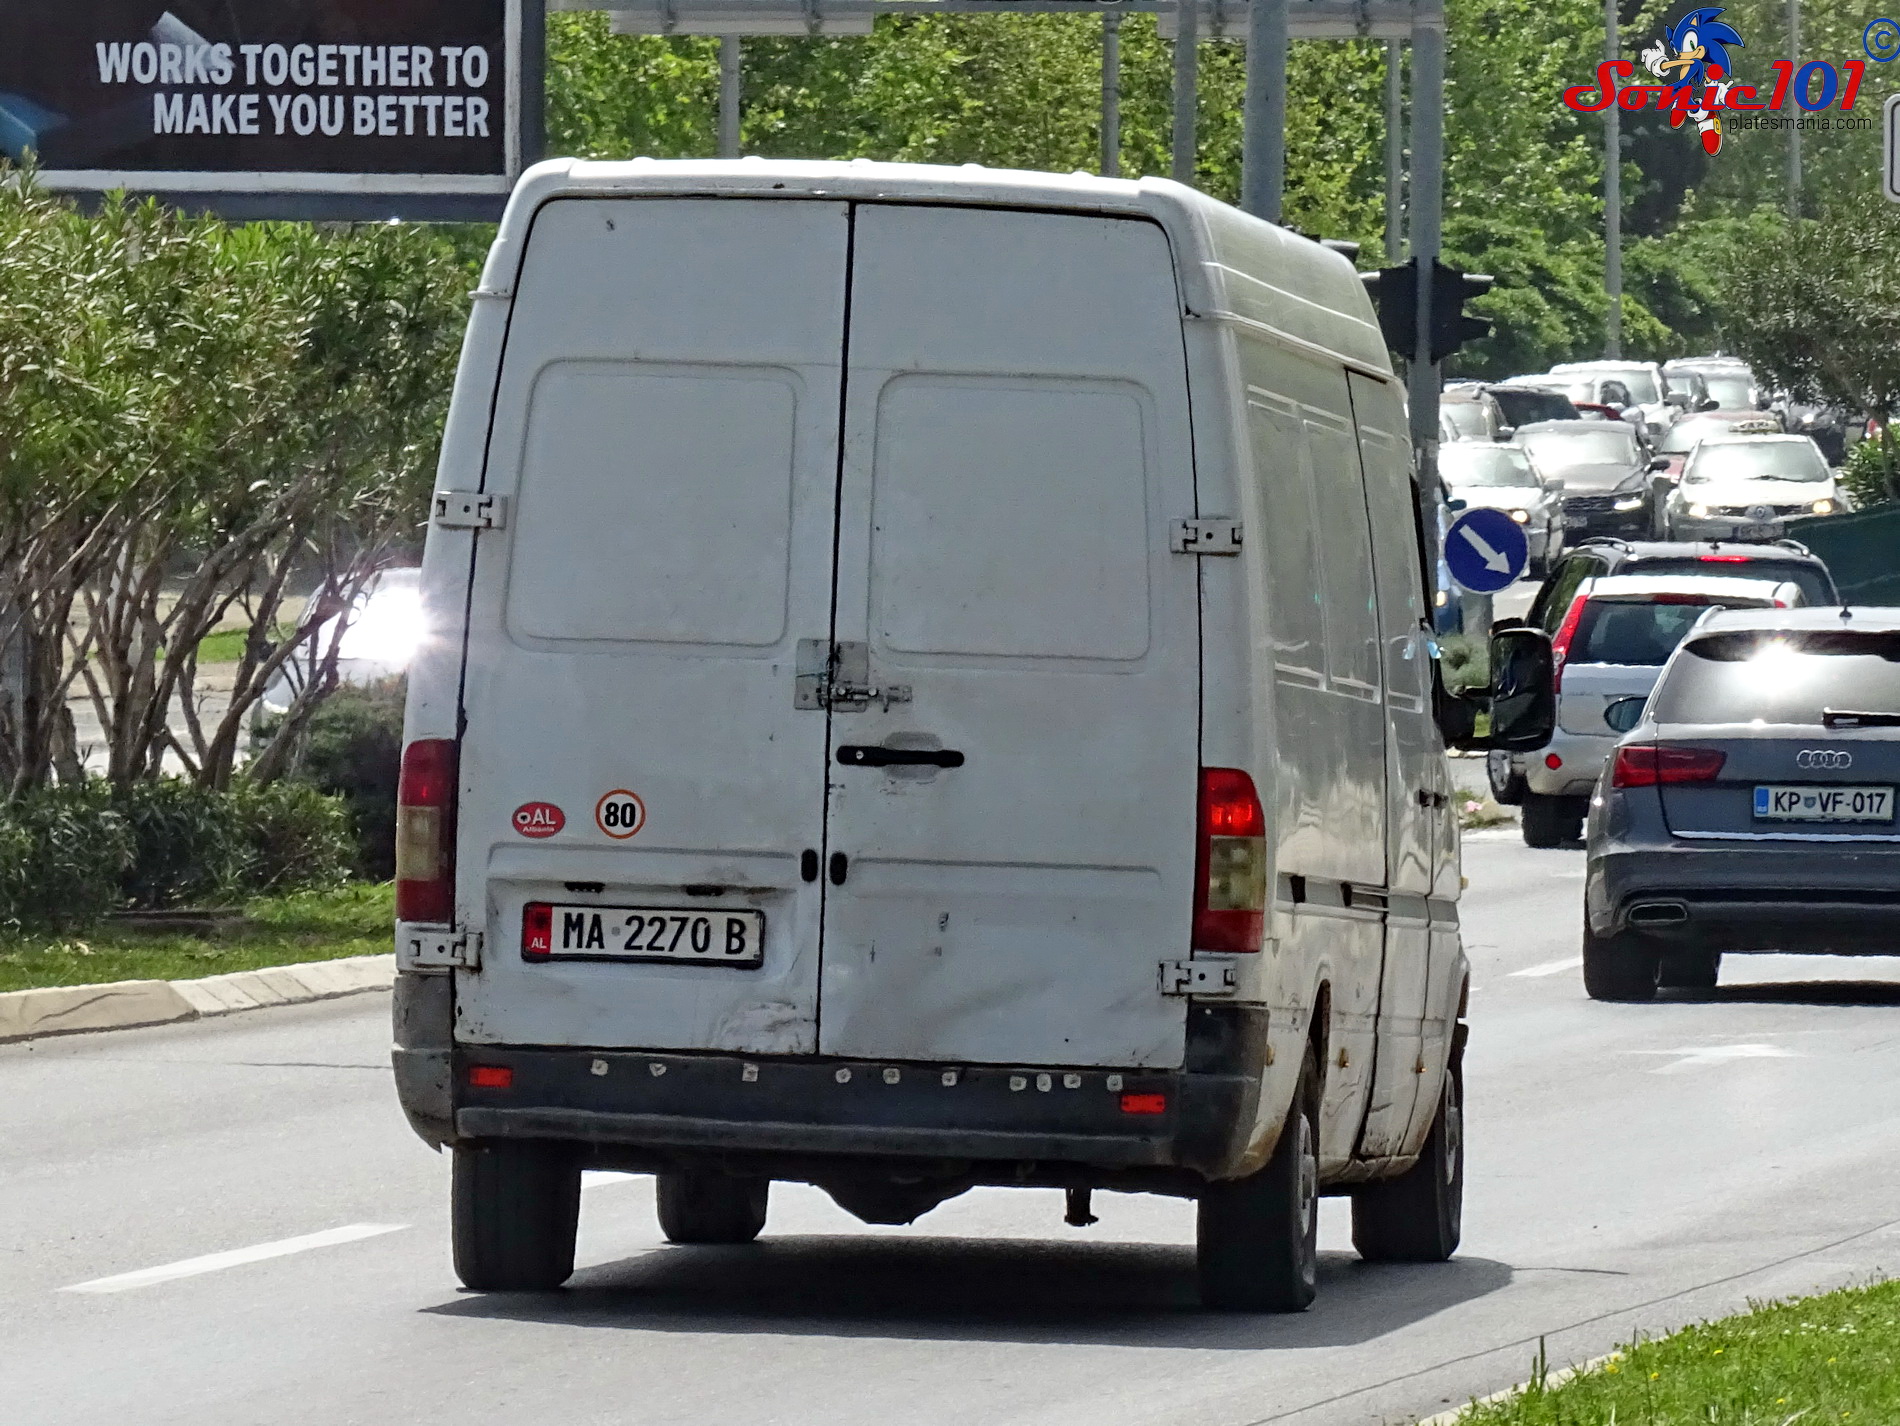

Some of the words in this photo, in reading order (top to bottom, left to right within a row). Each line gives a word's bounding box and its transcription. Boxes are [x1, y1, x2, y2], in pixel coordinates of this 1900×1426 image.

[96, 42, 233, 84] WORKS
[240, 43, 434, 87] TOGETHER
[440, 45, 489, 88] TO
[154, 93, 259, 134] MAKE
[268, 94, 344, 136] YOU
[353, 95, 490, 137] BETTER
[605, 802, 636, 828] 80
[531, 937, 547, 949] AL
[563, 913, 605, 949] MA
[624, 916, 711, 953] 2270
[725, 919, 746, 954] B
